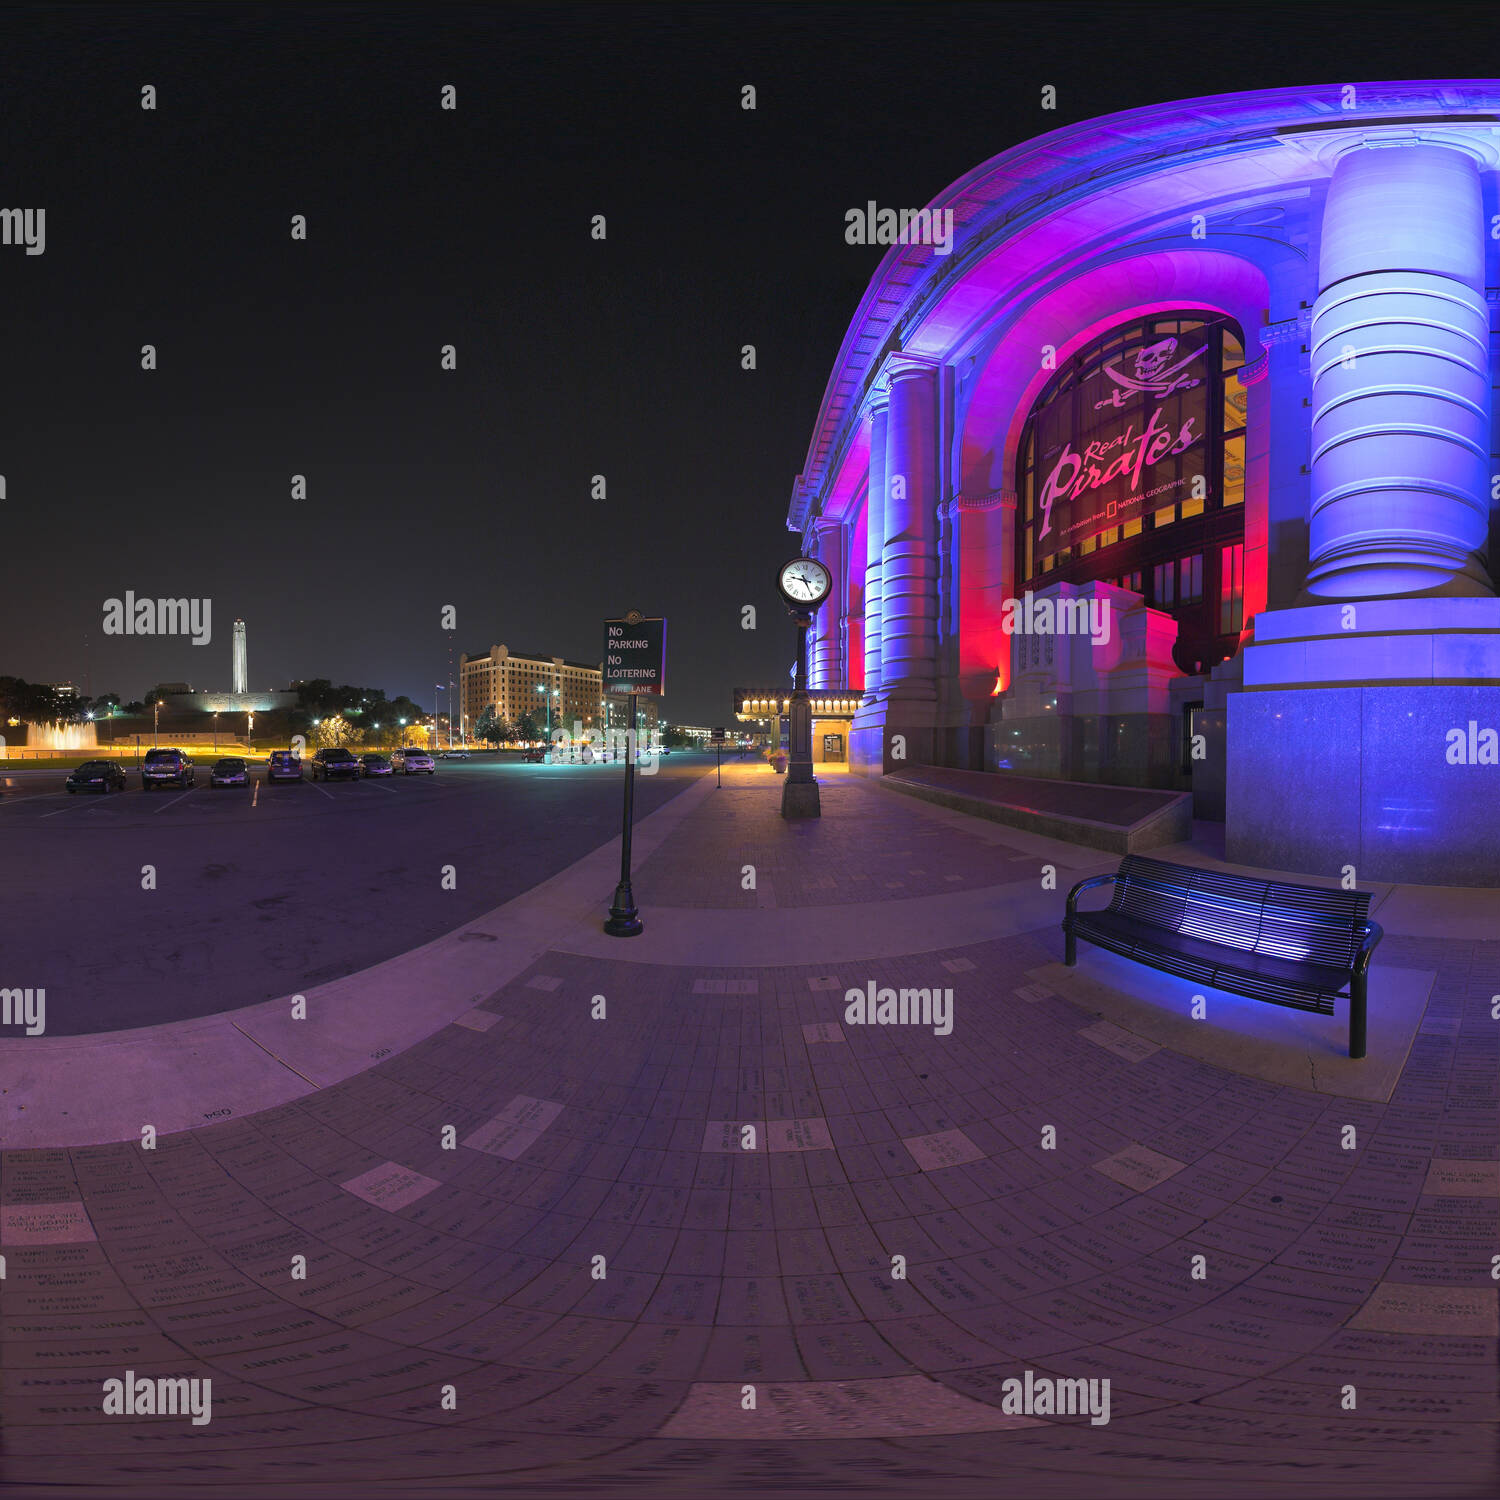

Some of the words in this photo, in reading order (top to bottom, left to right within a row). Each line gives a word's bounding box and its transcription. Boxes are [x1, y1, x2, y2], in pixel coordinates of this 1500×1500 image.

[1083, 425, 1133, 465] Real
[1038, 407, 1204, 542] Pirates
[1067, 517, 1091, 532] exhibition
[1092, 512, 1106, 522] from
[1118, 494, 1145, 510] NATIONAL
[1145, 477, 1186, 498] GEOGRAPHIC
[609, 626, 623, 637] NO
[608, 639, 649, 649] PARKING
[607, 655, 622, 665] NO
[607, 668, 656, 679] LOITERING
[610, 685, 628, 694] FIRE
[631, 685, 652, 694] LANE
[203, 1108, 232, 1120] 054
